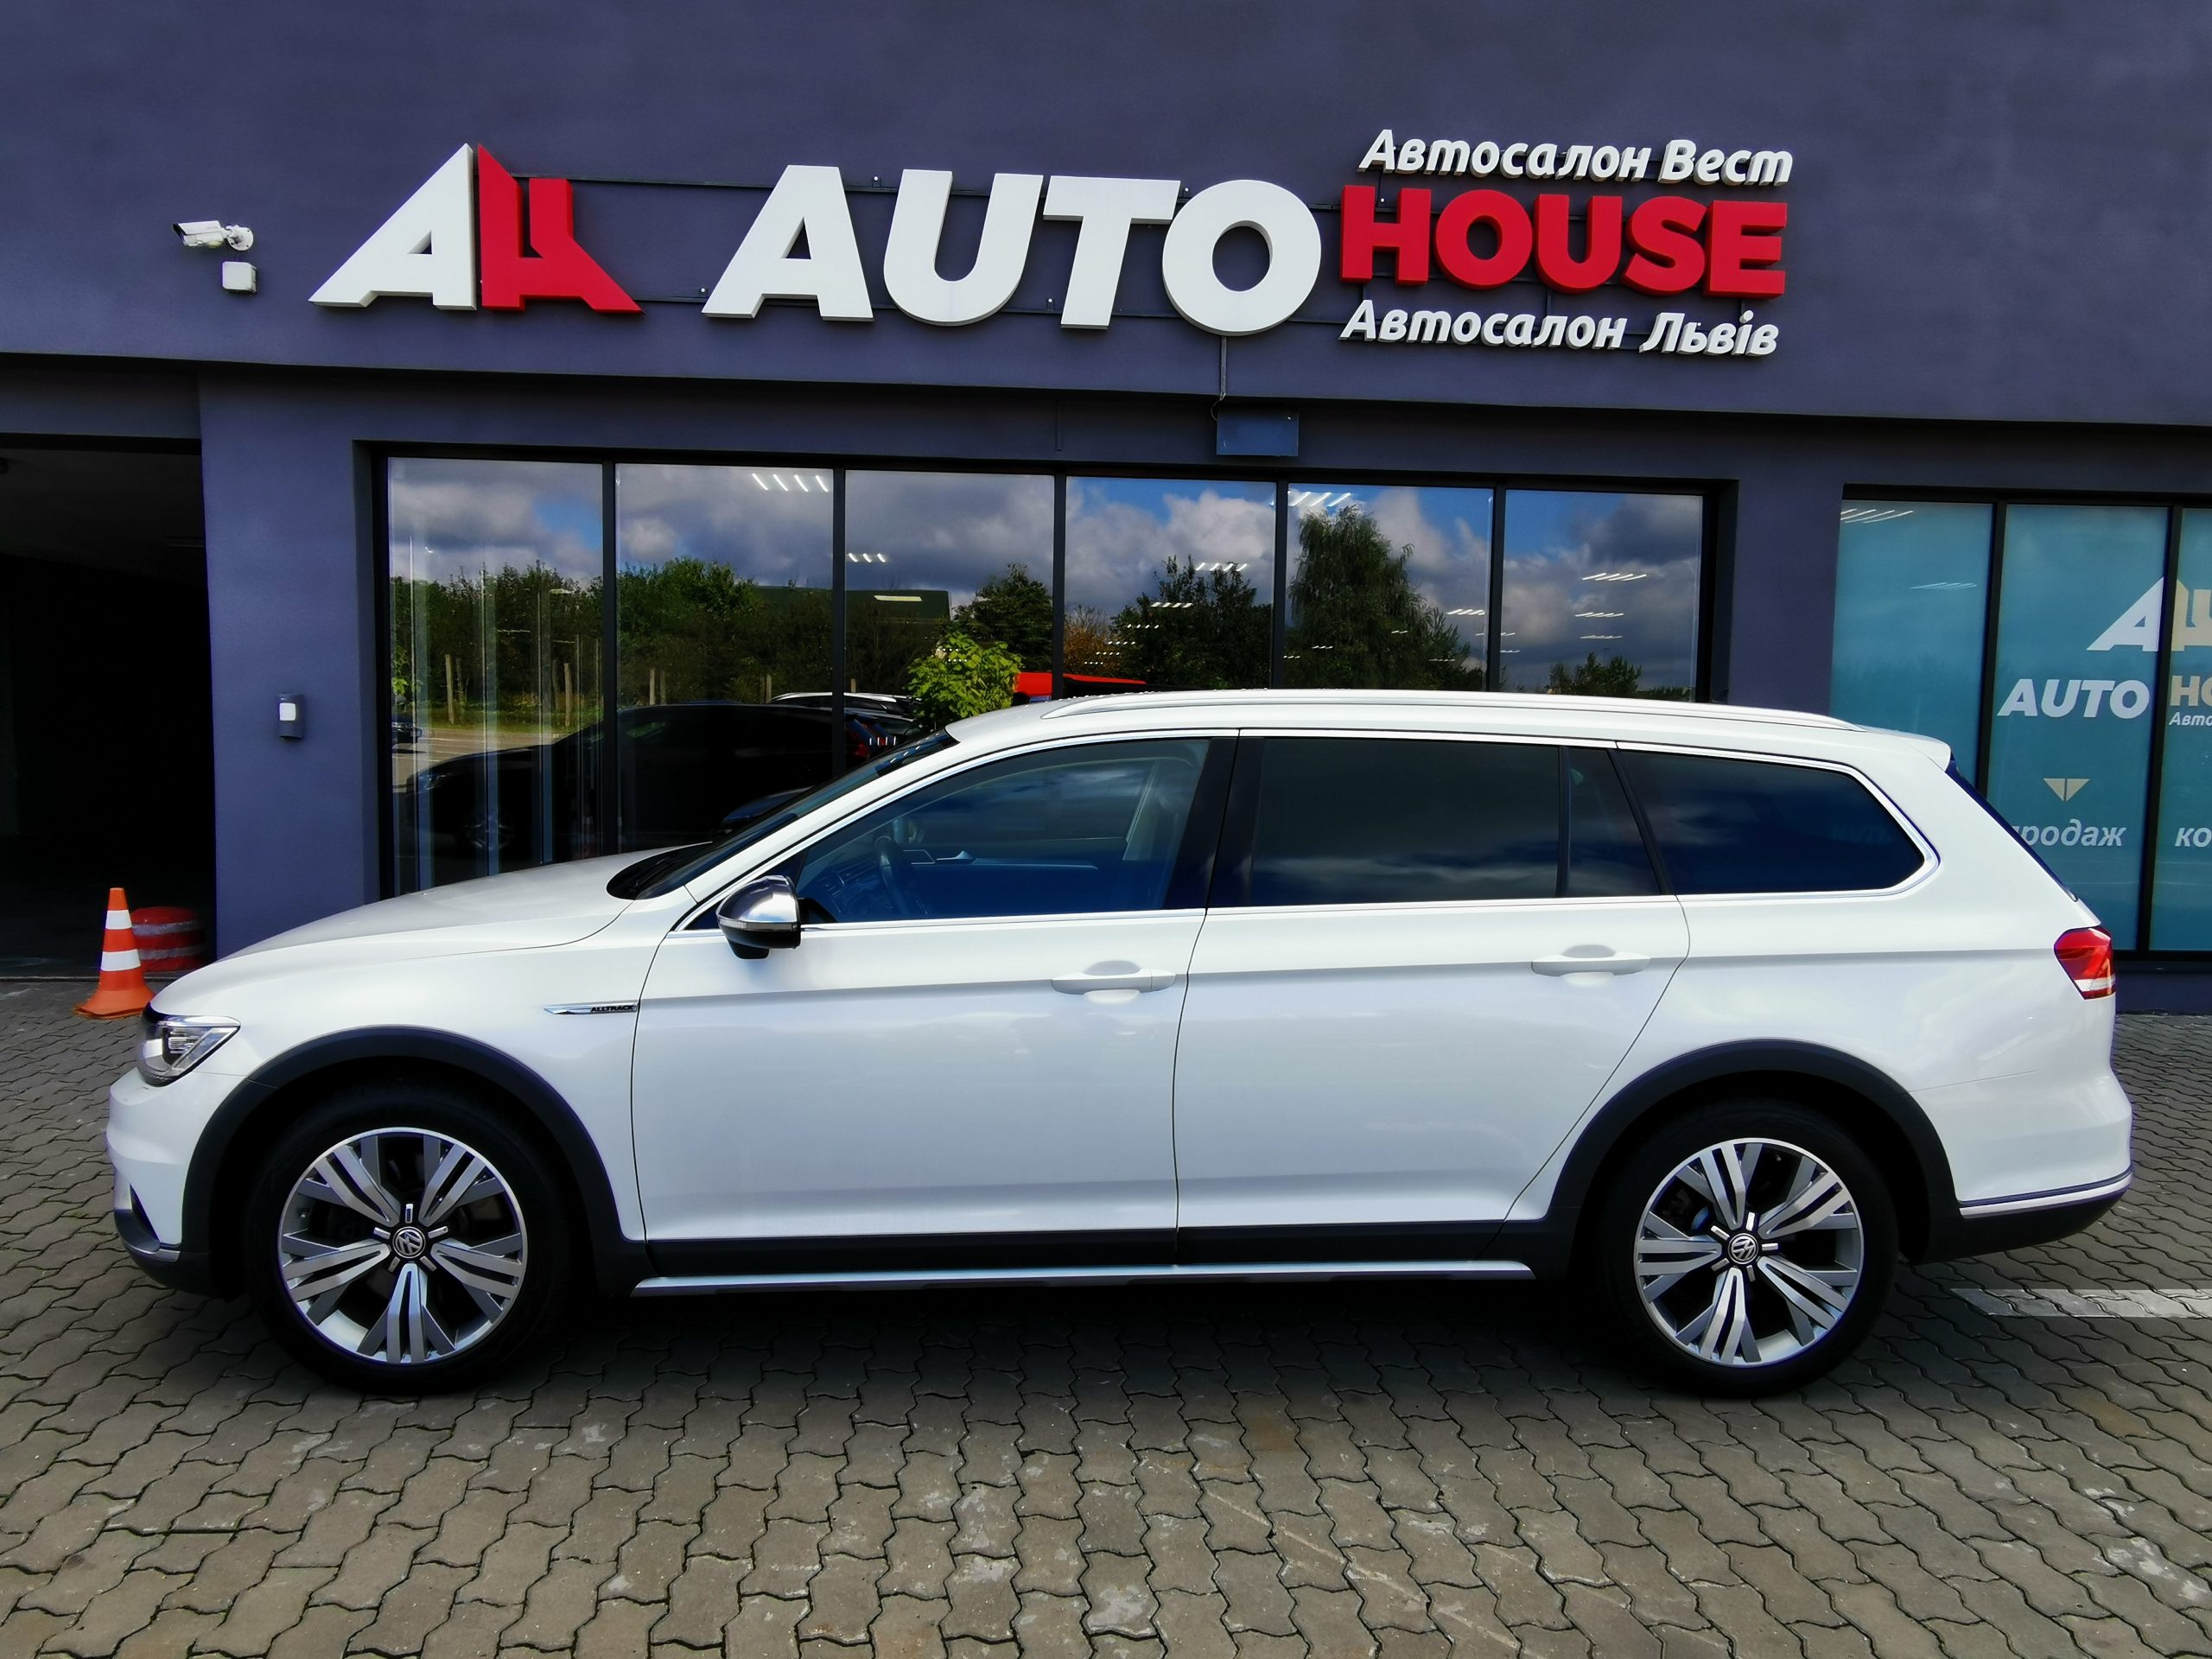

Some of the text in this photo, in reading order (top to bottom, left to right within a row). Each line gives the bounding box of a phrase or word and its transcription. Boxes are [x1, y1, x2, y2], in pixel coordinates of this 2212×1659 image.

[1357, 129, 1793, 186] Автосалон Вест
[702, 165, 1787, 336] AUTO HOUSE
[1338, 300, 1778, 357] Автосалон Львів
[1997, 679, 2150, 719] AUTO
[2012, 818, 2126, 847] родаж
